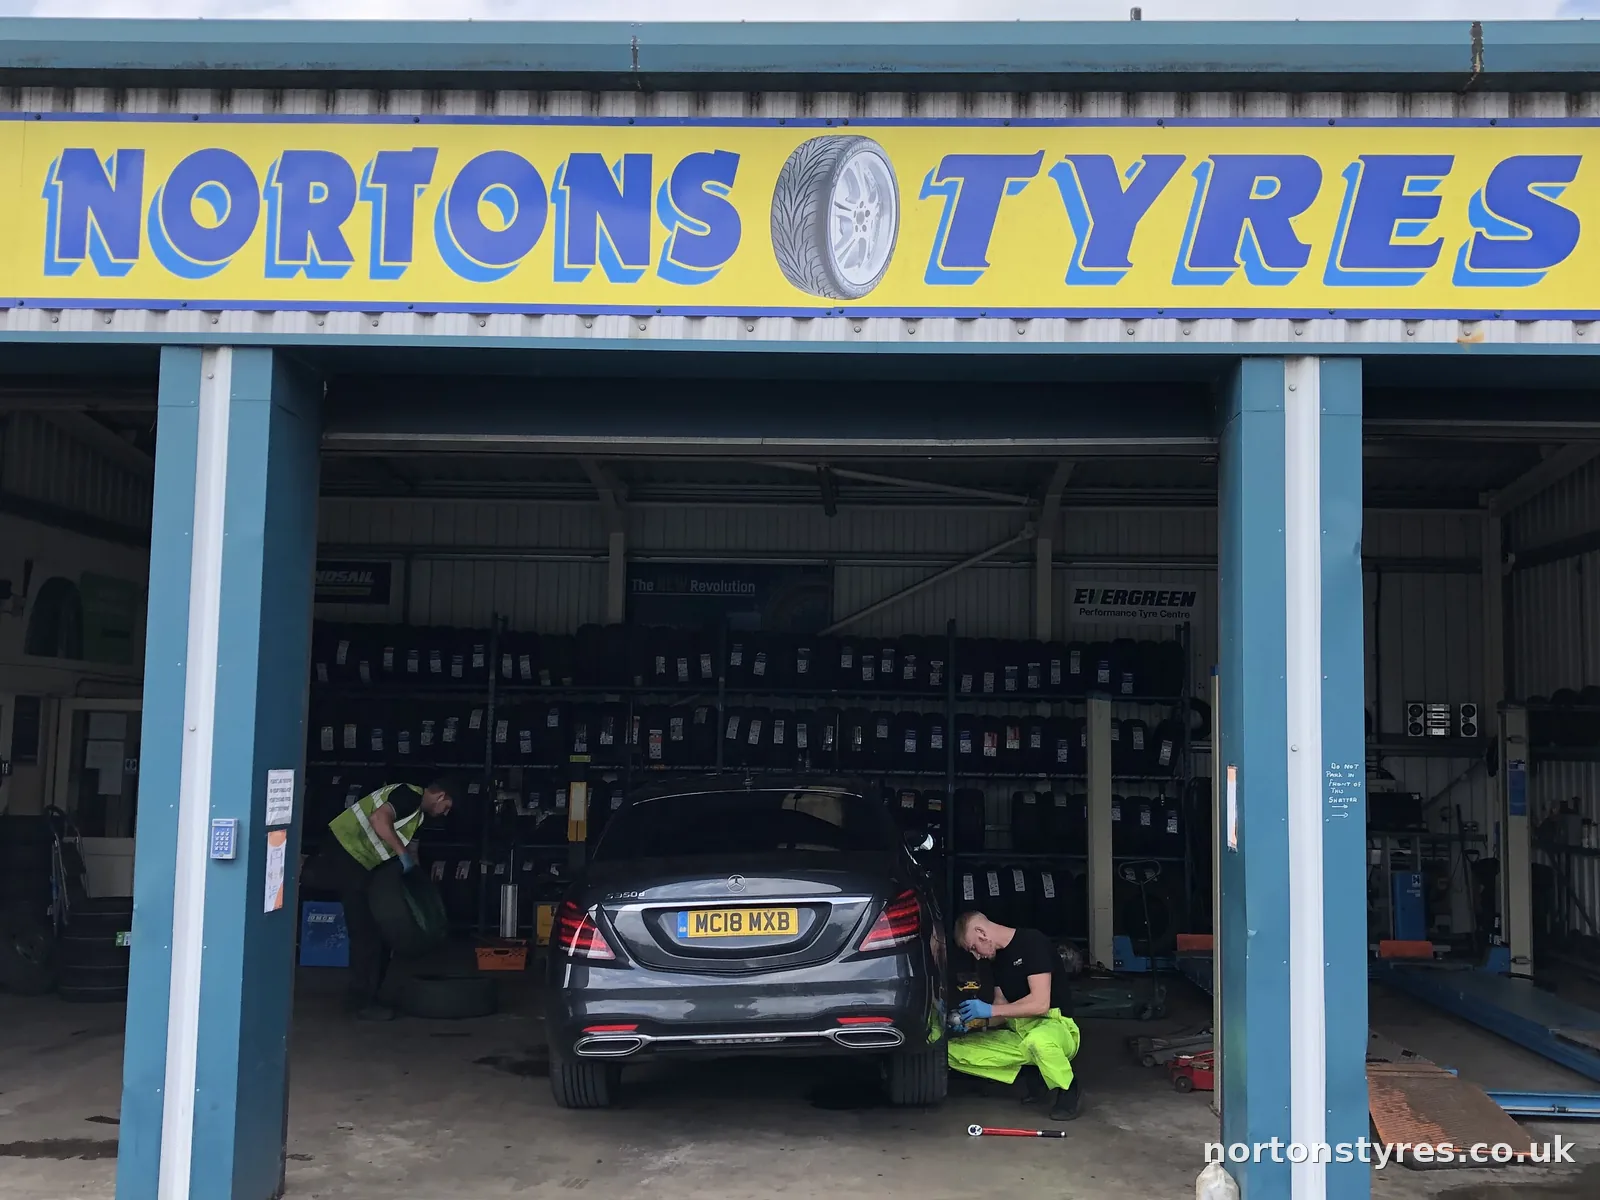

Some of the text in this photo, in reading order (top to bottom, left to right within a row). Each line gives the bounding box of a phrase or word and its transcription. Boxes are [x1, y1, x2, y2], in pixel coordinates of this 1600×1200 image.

[41, 147, 1583, 288] NORTONS TYRES
[631, 578, 654, 591] The
[690, 579, 756, 593] Revolution
[1074, 588, 1197, 607] EVERGREEN
[1079, 608, 1191, 619] Performance Tyre Centre
[695, 910, 791, 934] MC18 MXB
